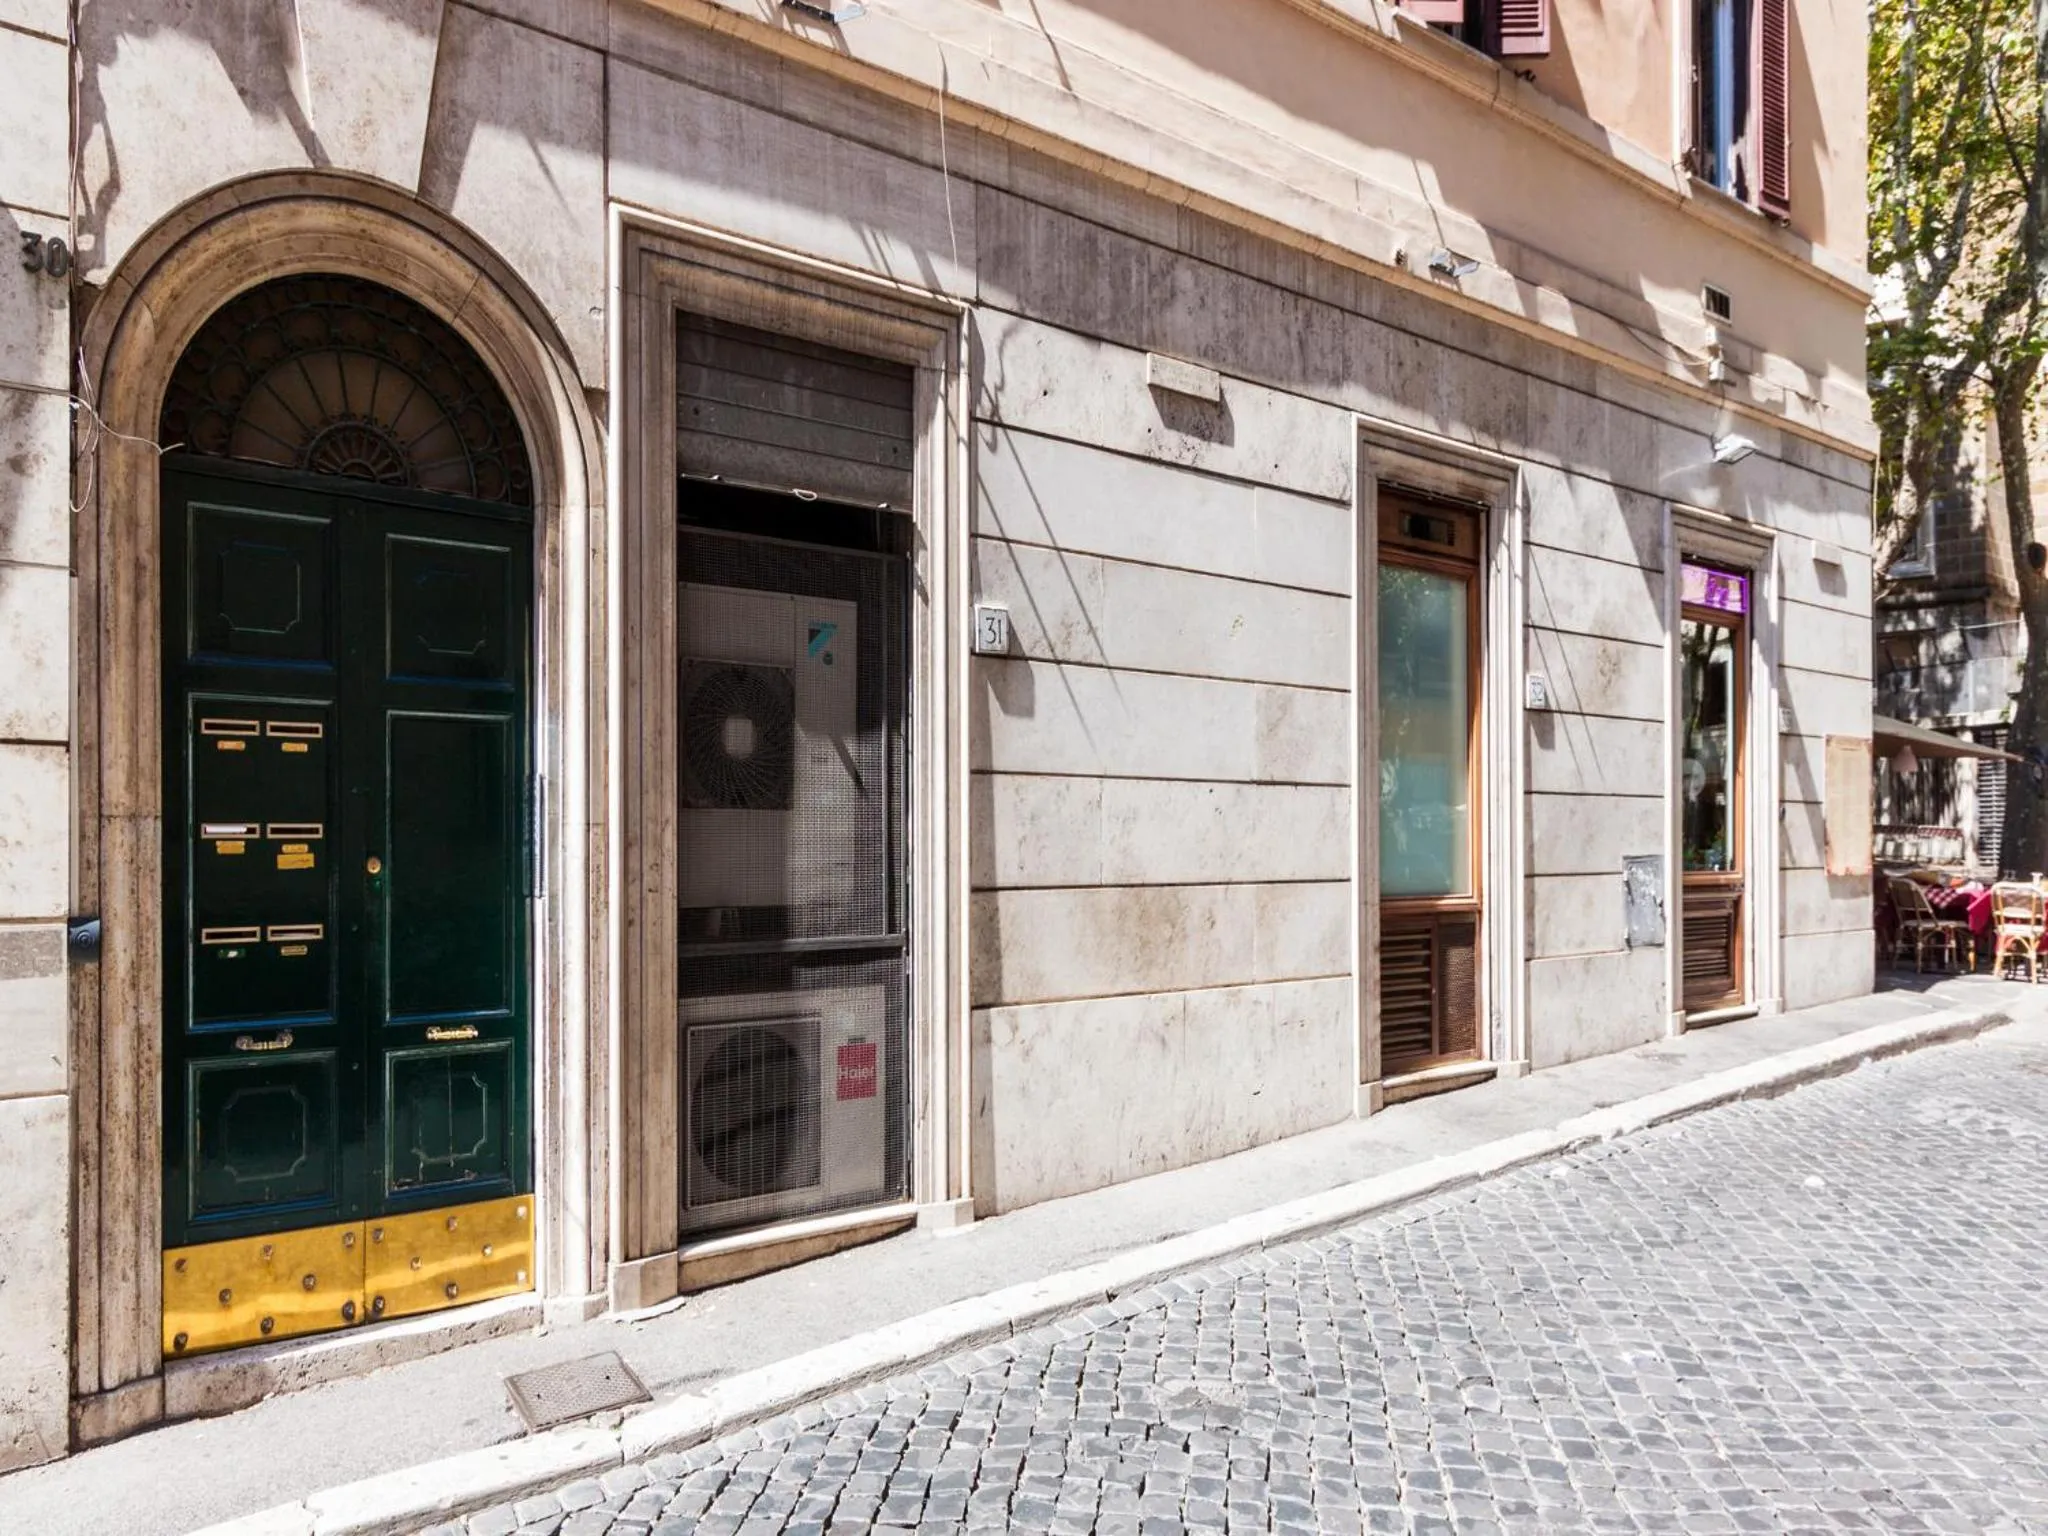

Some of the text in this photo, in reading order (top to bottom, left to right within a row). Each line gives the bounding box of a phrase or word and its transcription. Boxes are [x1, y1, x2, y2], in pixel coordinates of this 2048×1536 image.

[20, 231, 68, 278] 30
[985, 616, 1002, 645] 31
[838, 1065, 875, 1081] Haier
